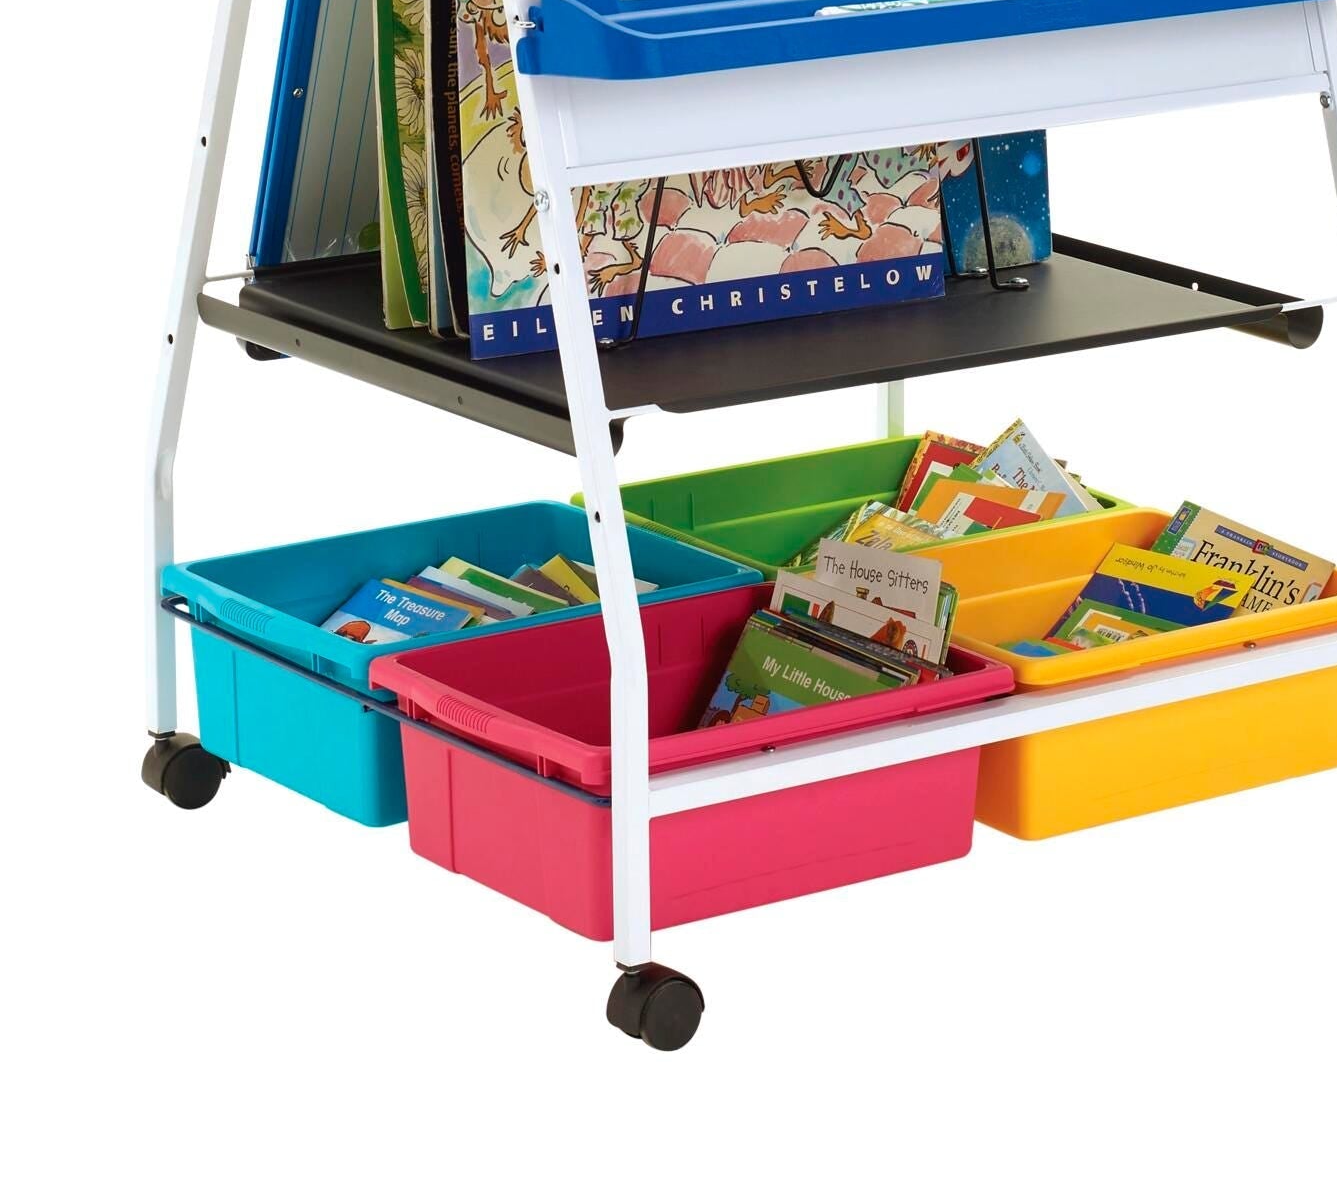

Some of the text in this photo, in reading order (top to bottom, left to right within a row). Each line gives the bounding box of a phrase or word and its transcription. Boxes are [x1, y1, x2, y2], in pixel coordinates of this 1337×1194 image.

[484, 264, 934, 341] EILEN CHRISTELOW
[824, 556, 929, 595] The House Sitters
[1190, 539, 1300, 606] Franklin's
[375, 589, 446, 621] The Treasure
[384, 608, 411, 627] Map
[762, 656, 782, 678] My
[782, 664, 811, 689] Little
